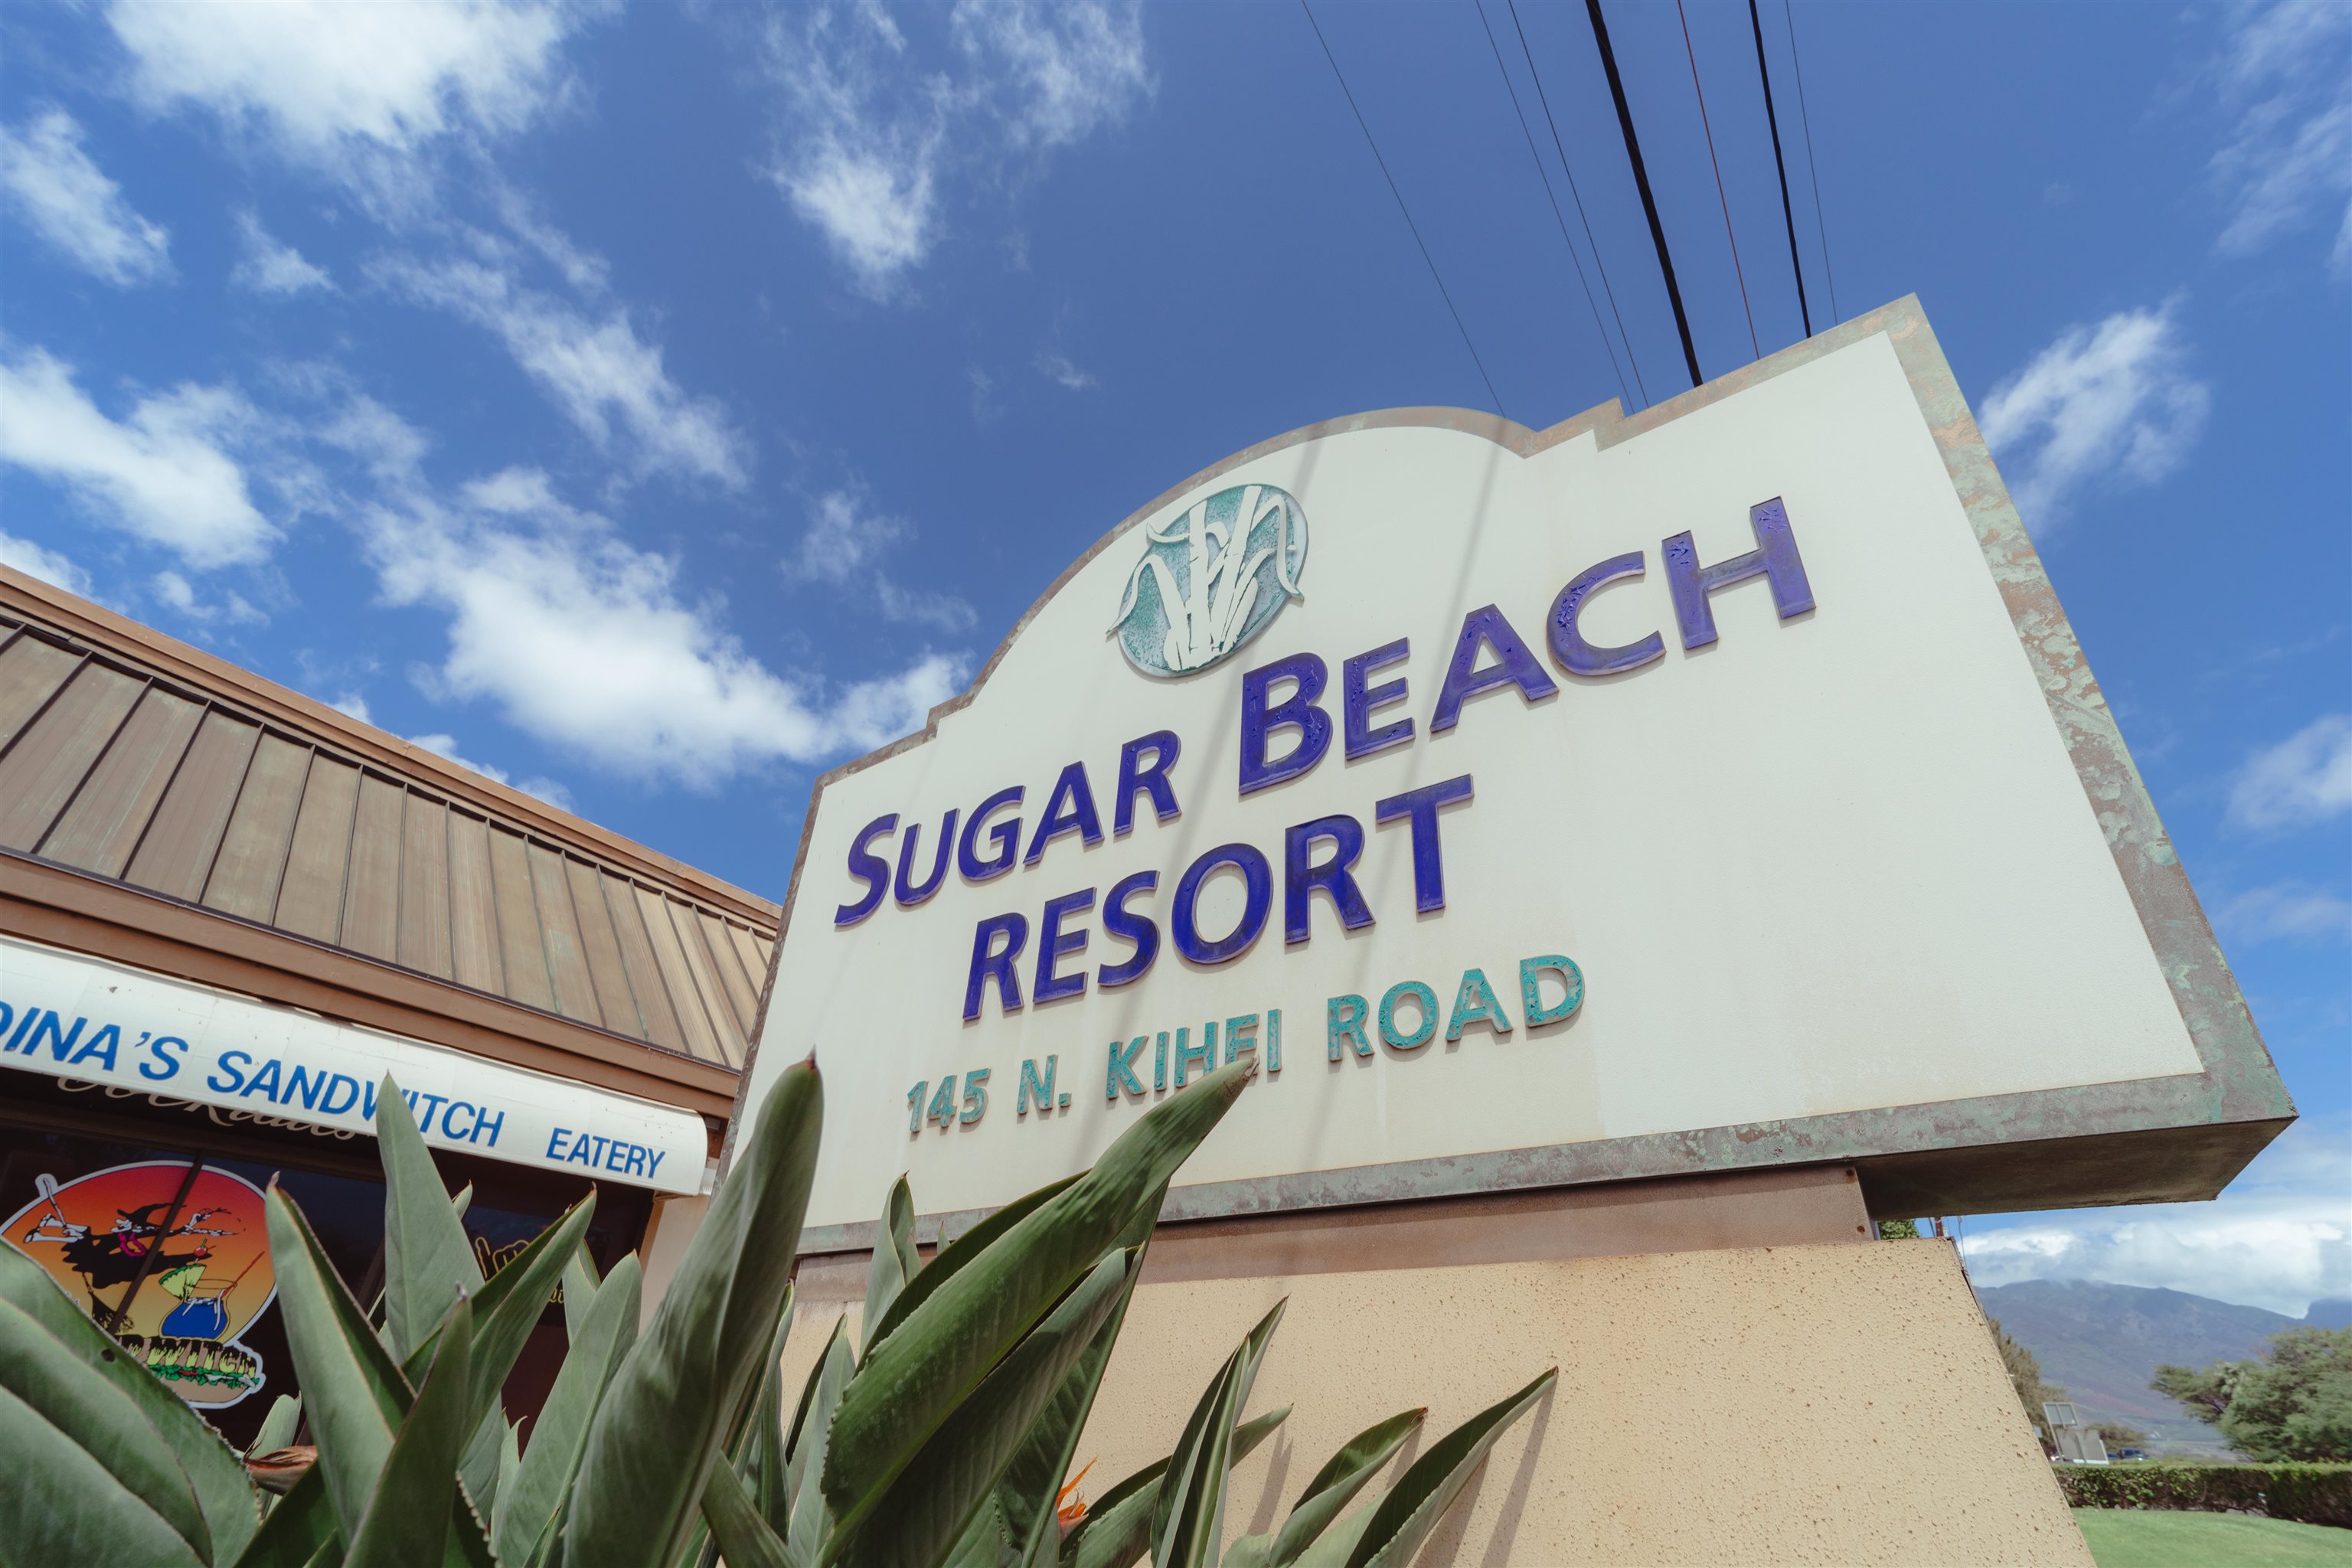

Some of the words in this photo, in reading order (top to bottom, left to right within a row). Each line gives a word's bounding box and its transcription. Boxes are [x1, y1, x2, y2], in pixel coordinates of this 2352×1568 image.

[834, 730, 1181, 928] SUGAR
[1238, 495, 1817, 795] BEACH
[962, 773, 1475, 1022] RESORT
[906, 1067, 991, 1132] 145
[1017, 1054, 1071, 1114] N.
[1106, 1008, 1282, 1099] KIHEI
[1327, 954, 1585, 1062] ROAD
[546, 1127, 665, 1179] EATERY
